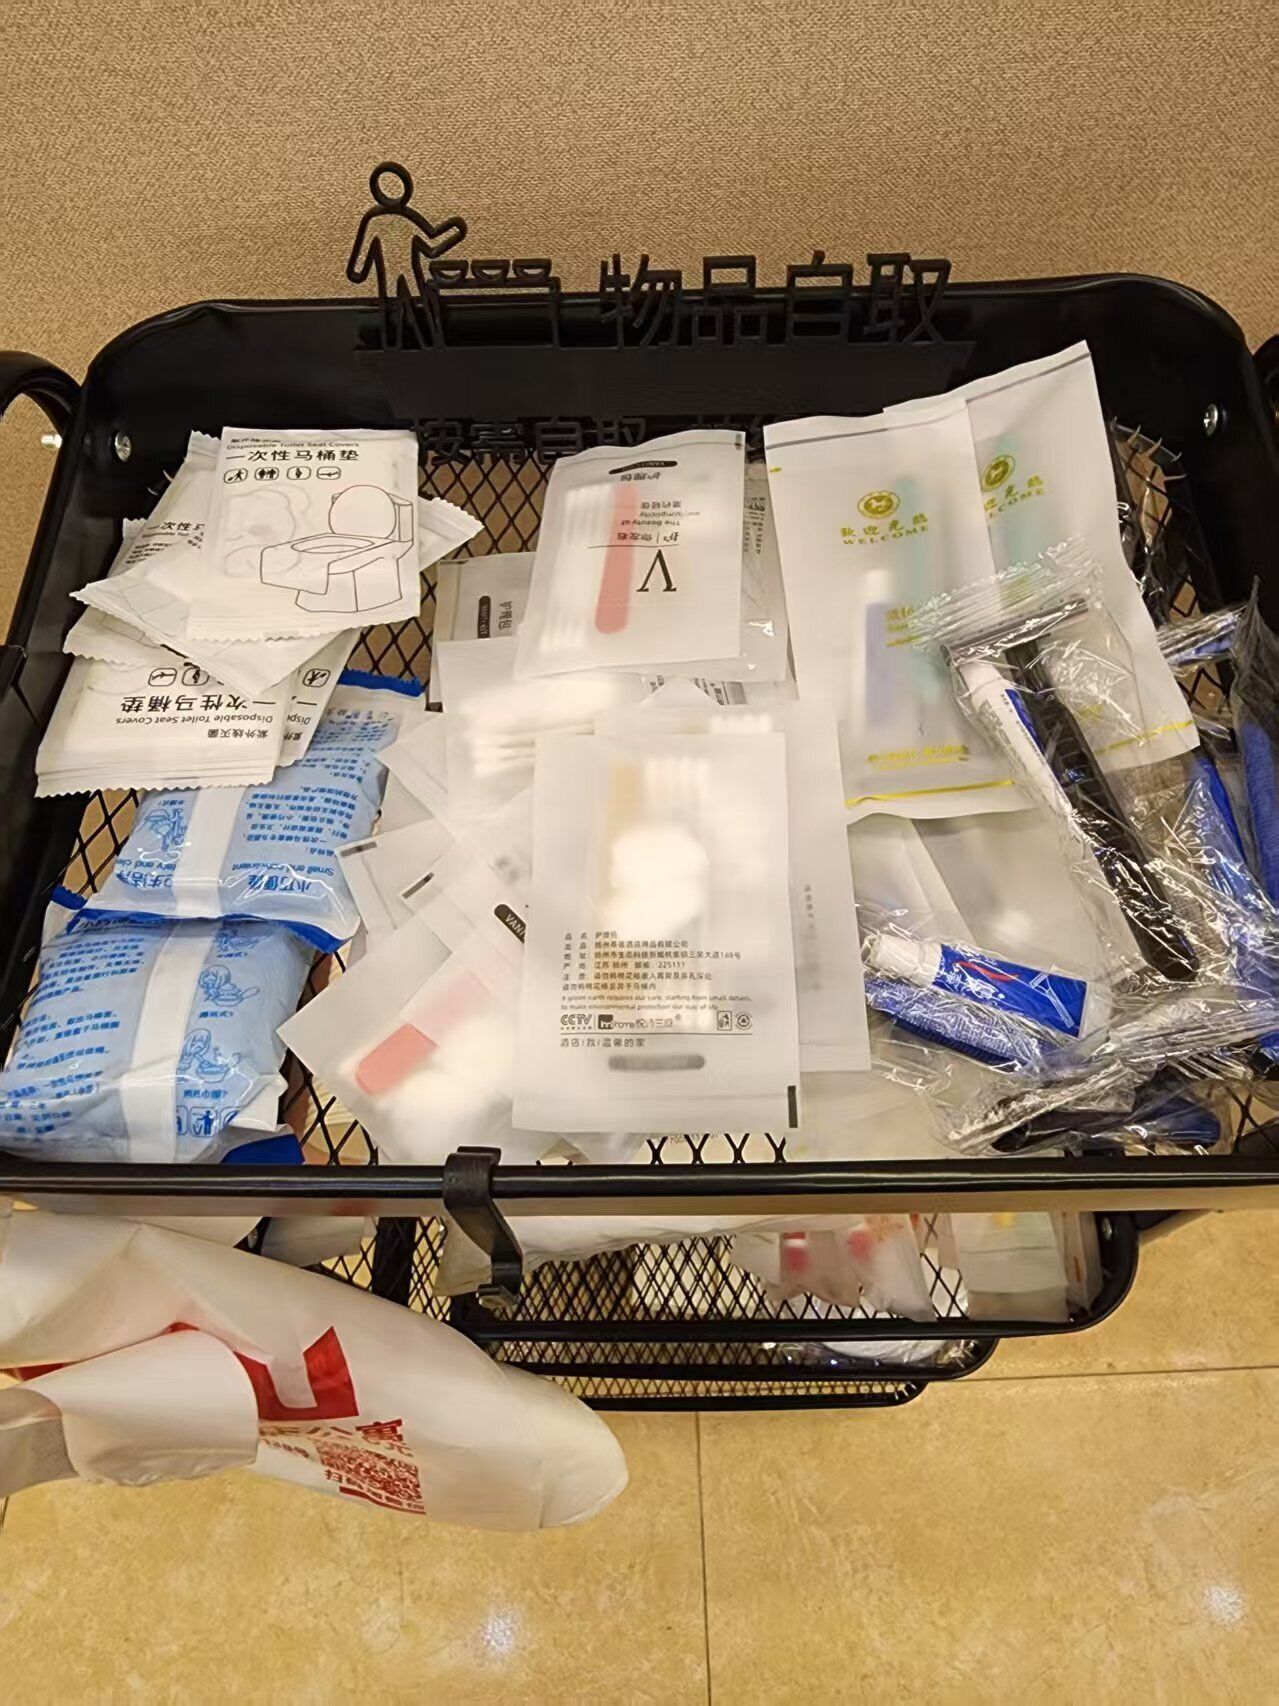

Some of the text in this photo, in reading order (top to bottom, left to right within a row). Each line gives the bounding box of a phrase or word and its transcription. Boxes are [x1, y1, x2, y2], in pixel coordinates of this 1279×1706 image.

[225, 449, 360, 462] 一次性马桶垫
[148, 521, 205, 531] 一次性马
[120, 694, 276, 713] 一次性马桶垫
[115, 713, 273, 725] Disposable Toilet Seat Covers
[207, 728, 268, 739] 紫外线灭菌
[560, 1013, 592, 1025] CCTV
